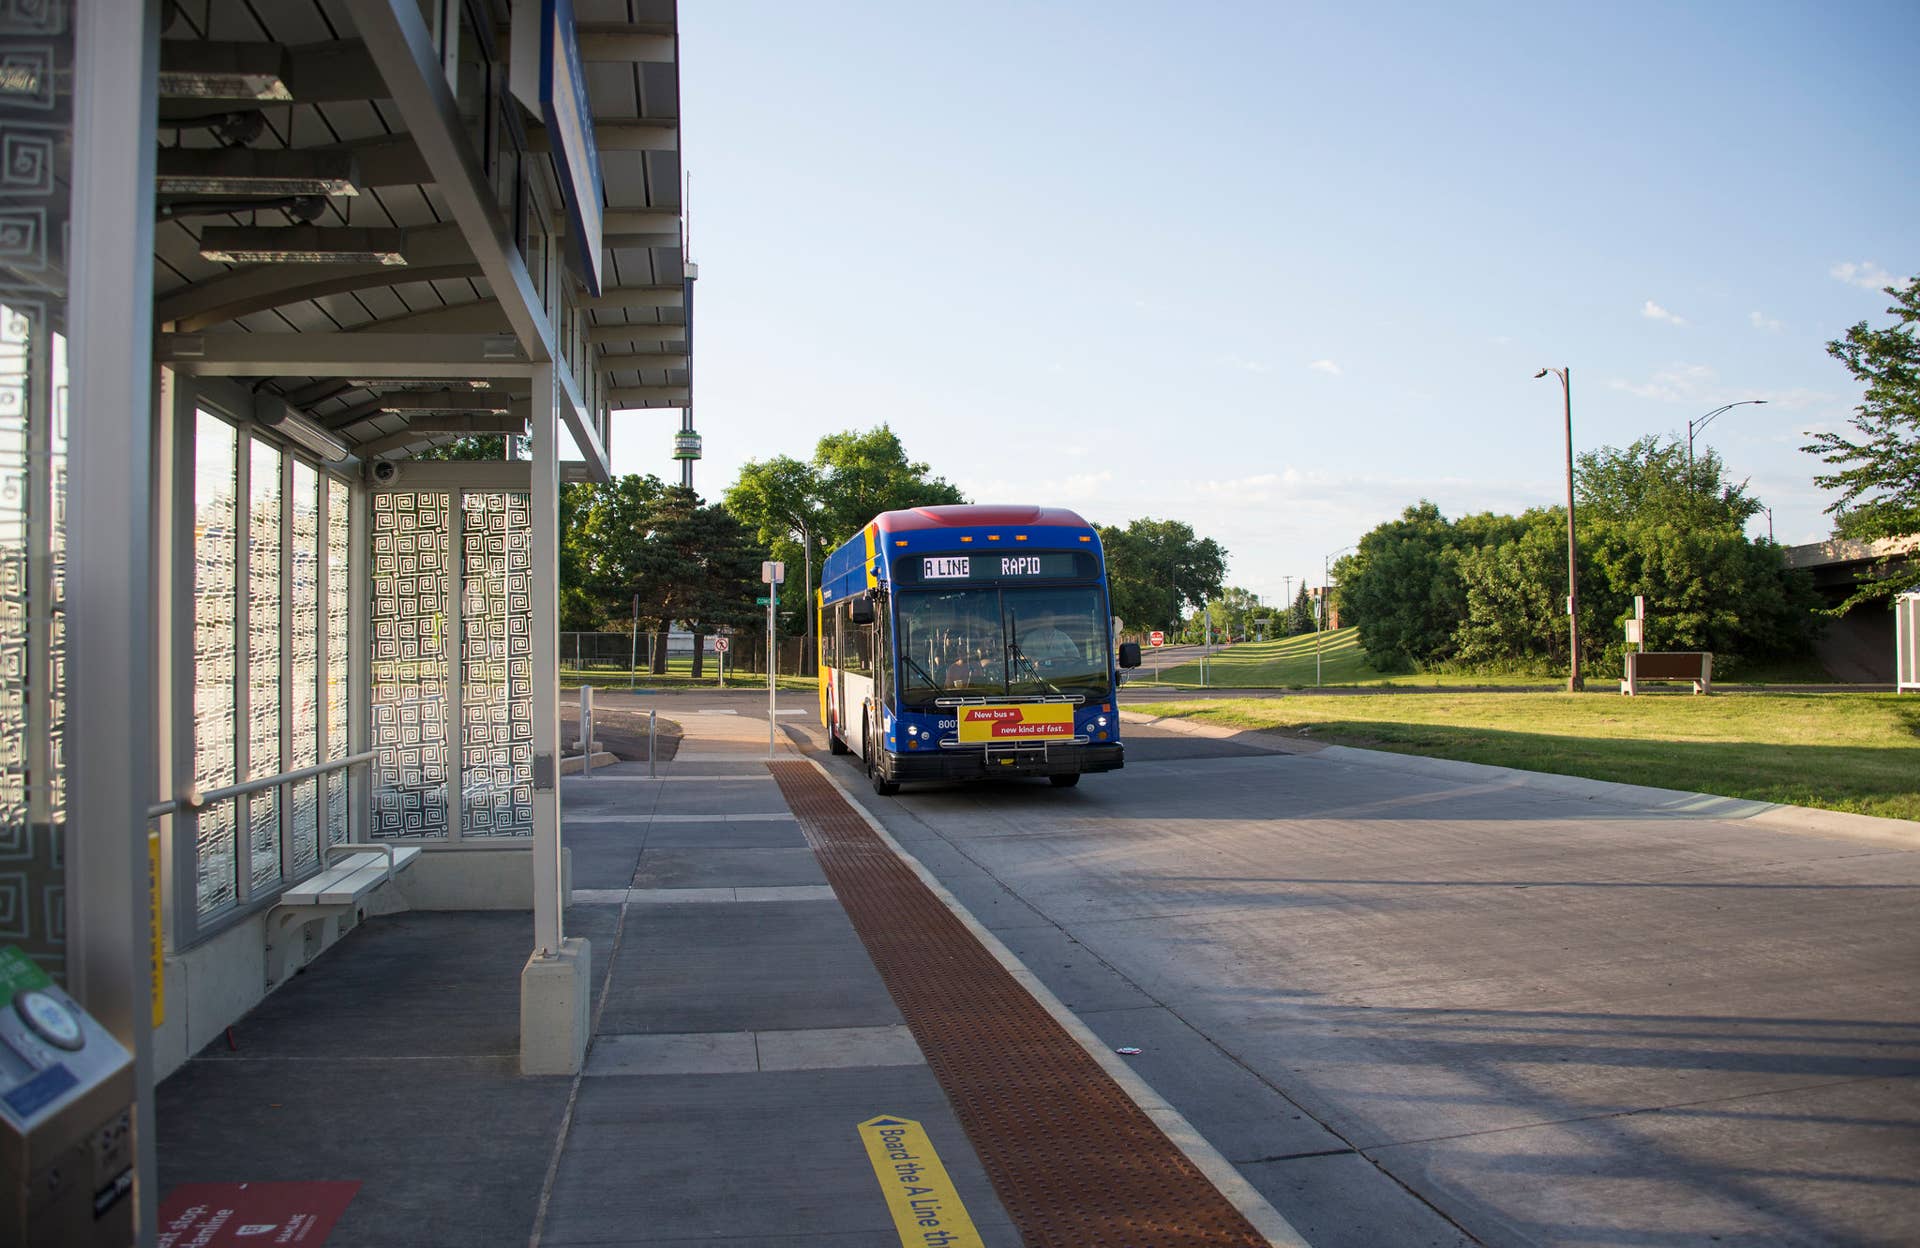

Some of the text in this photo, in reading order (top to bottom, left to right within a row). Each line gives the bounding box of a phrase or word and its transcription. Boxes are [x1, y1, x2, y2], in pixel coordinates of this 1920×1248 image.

[925, 556, 1041, 577] A LINE RAPID
[974, 711, 992, 719] New
[993, 710, 1008, 718] bus
[1018, 725, 1035, 733] kind
[1036, 725, 1045, 733] of
[1047, 724, 1065, 732] fast.
[880, 1129, 958, 1248] Board the A Line th
